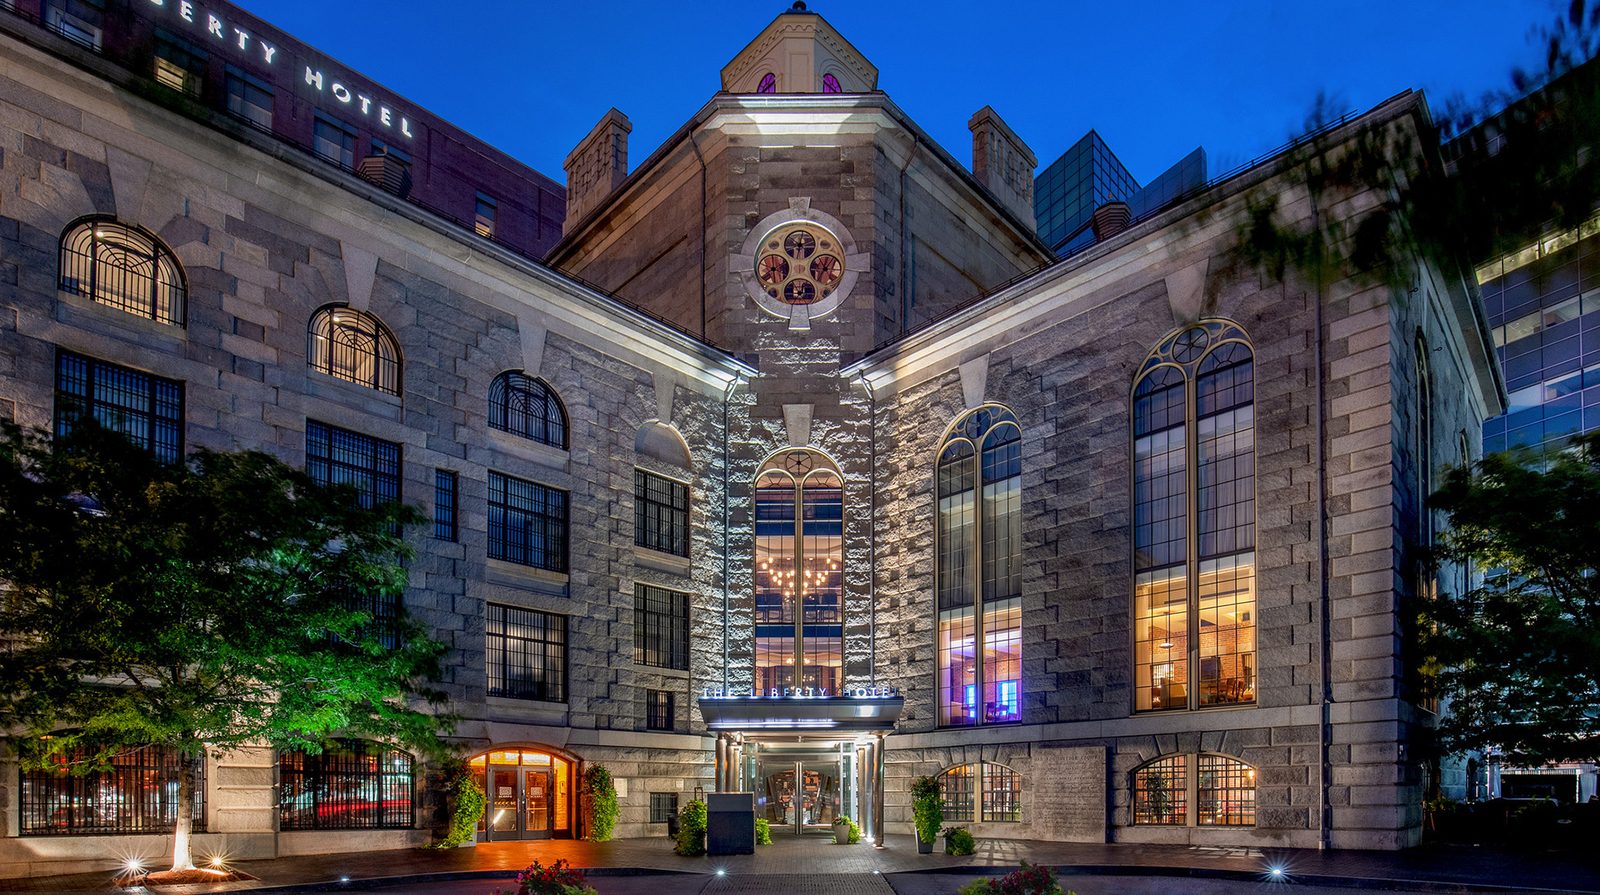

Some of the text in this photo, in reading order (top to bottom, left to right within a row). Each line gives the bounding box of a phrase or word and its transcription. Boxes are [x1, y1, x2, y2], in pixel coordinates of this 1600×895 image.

[150, 0, 412, 138] ERTY HOTEL
[703, 687, 735, 698] THE
[750, 687, 828, 698] LIBERTY
